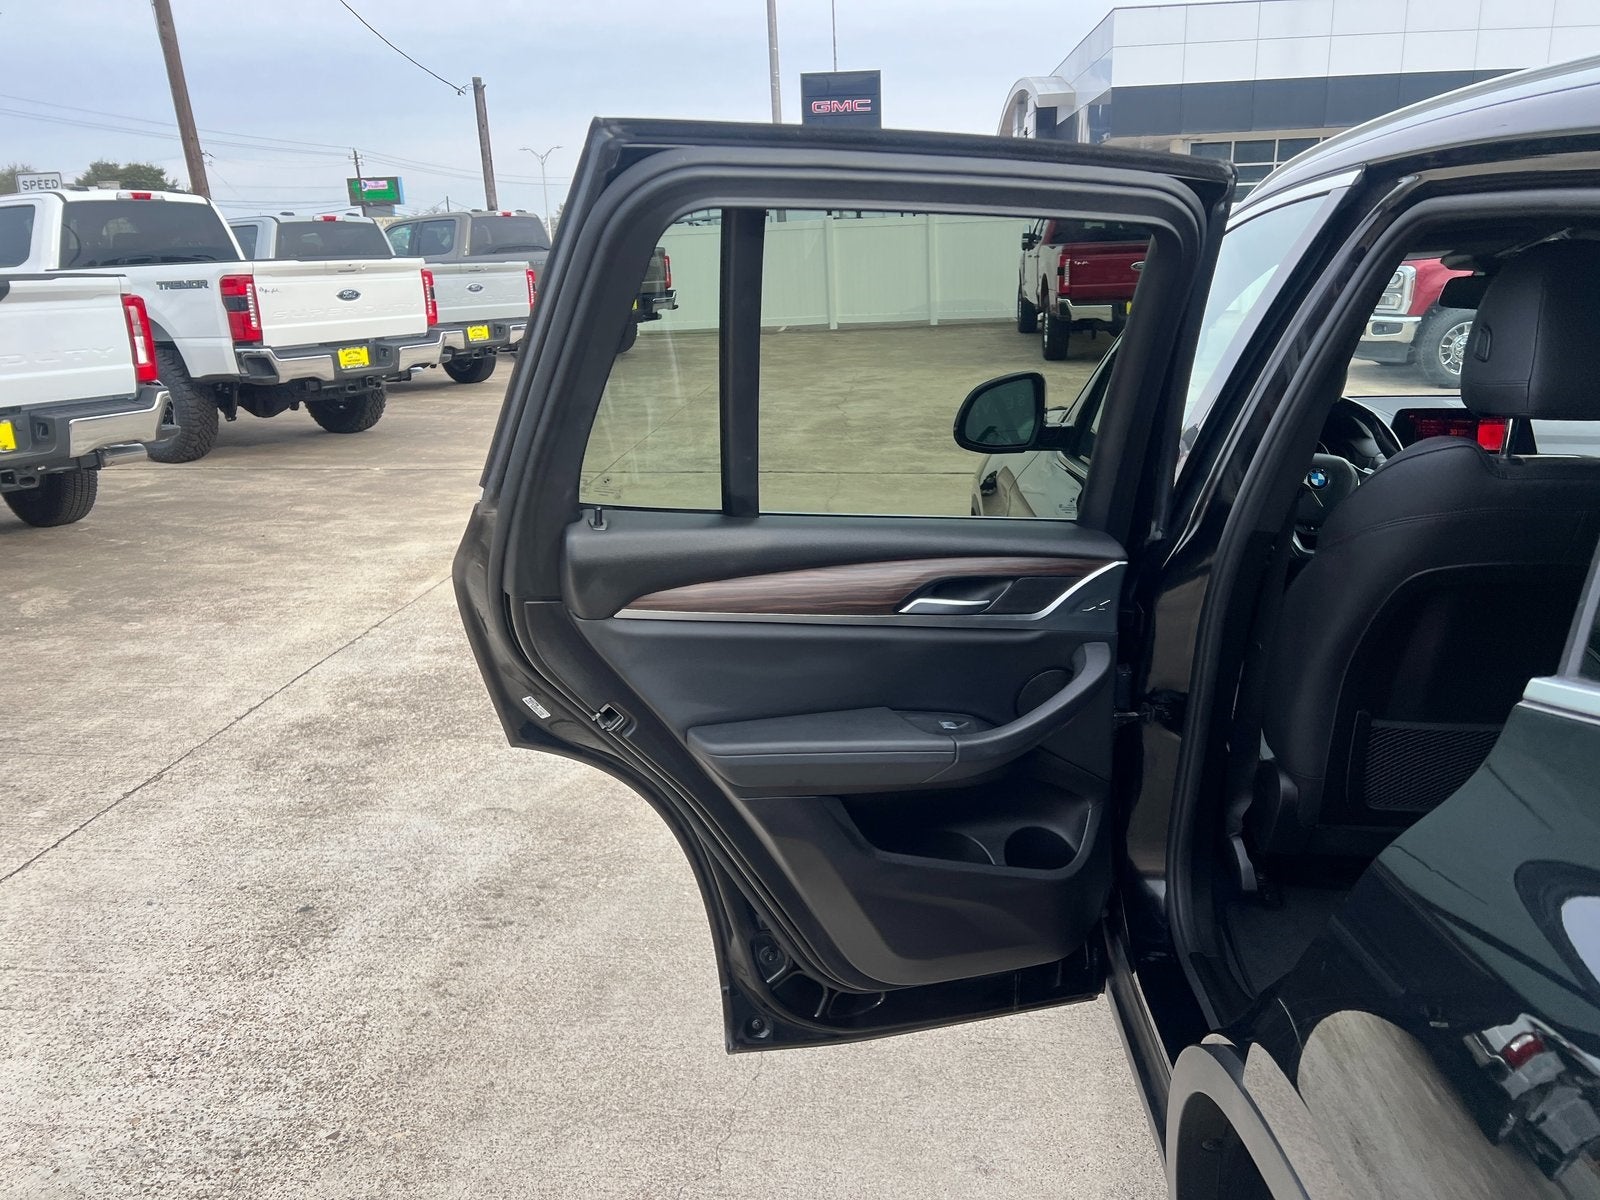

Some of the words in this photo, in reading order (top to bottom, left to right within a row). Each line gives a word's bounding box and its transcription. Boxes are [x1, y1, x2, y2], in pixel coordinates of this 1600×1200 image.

[811, 99, 871, 113] GMC
[22, 179, 59, 190] SPEED
[156, 279, 209, 290] TREMOR
